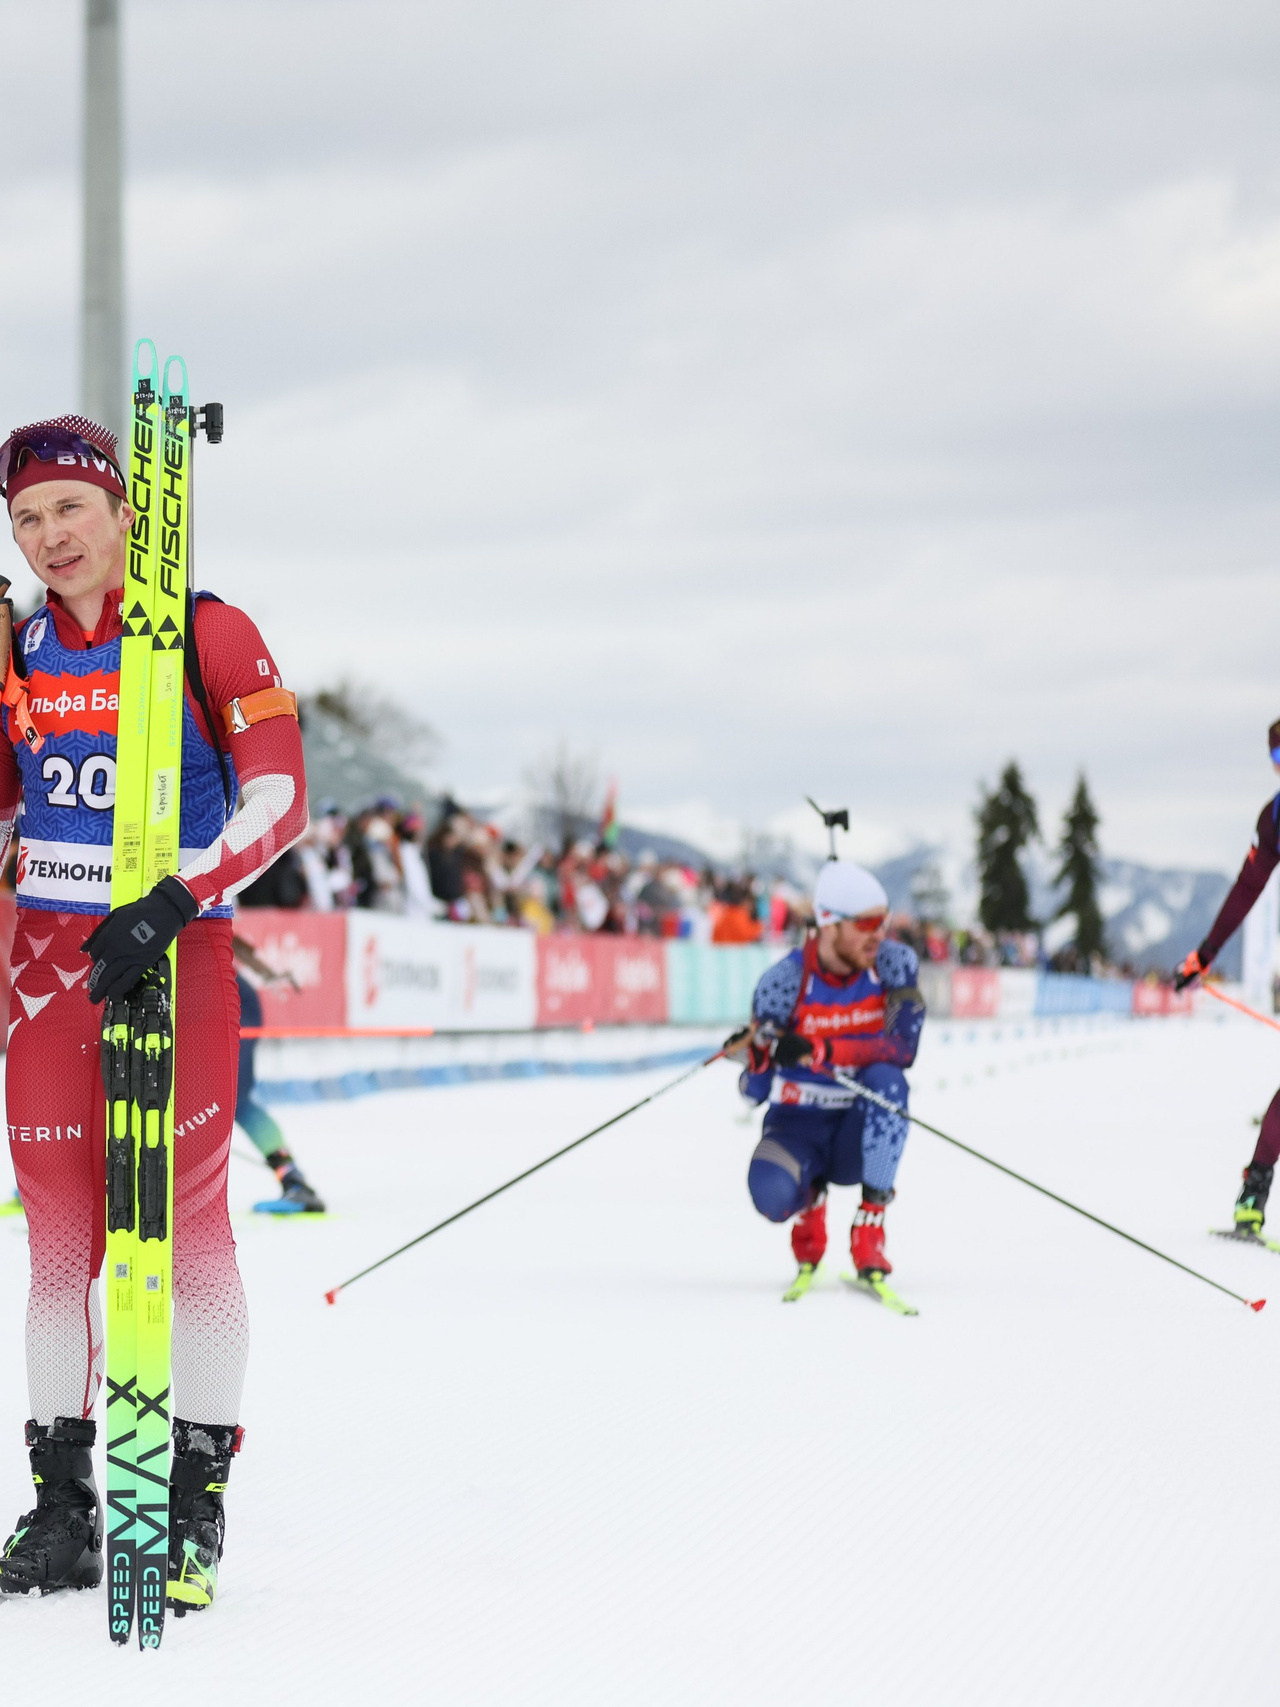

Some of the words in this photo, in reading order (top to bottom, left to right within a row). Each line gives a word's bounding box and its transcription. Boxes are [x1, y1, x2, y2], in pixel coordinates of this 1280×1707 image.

[130, 401, 154, 586] FISCHER
[160, 416, 184, 600] FISCHER
[29, 690, 86, 718] льфа
[43, 753, 118, 812] 20
[107, 1375, 137, 1541] MAX
[137, 1383, 170, 1555] MAX
[111, 1551, 131, 1634] SPEED
[141, 1565, 161, 1649] SPEED
